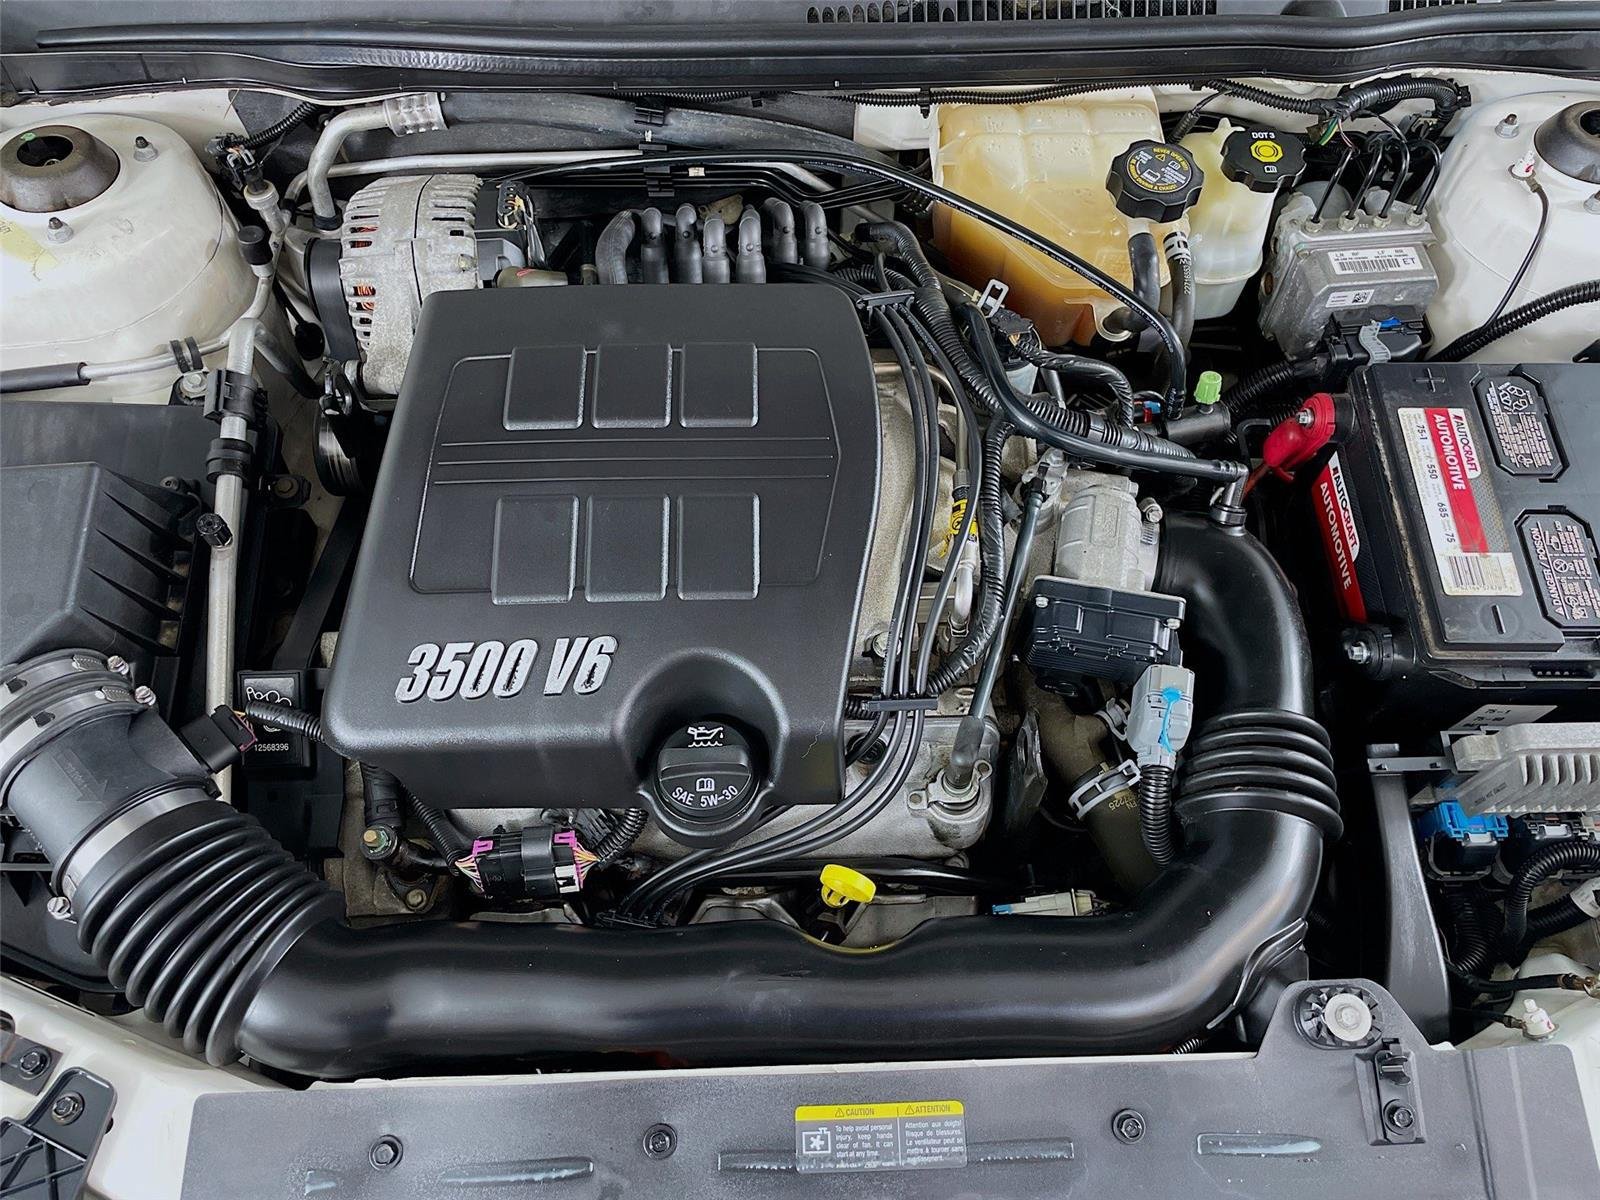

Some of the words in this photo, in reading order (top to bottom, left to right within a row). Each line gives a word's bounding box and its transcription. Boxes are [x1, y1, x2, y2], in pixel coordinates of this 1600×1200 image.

[1402, 257, 1416, 266] ET
[1432, 413, 1466, 491] AUTOMOTIVE
[1454, 419, 1478, 473] AUTOCRAFT
[1416, 424, 1429, 440] 75-1
[1426, 464, 1439, 480] 550
[1444, 532, 1456, 543] 75
[1333, 472, 1359, 548] AUTOCRAFT
[1320, 481, 1352, 590] AUTOMOTIVE
[1530, 527, 1548, 561] POISON
[1542, 568, 1562, 606] DANGER
[394, 640, 539, 704] 3500
[543, 635, 619, 697] V6
[254, 743, 290, 752] 12568396
[672, 786, 696, 806] SAE
[700, 784, 739, 808] 5W-30
[845, 1107, 875, 1117] CAUTION
[914, 1103, 951, 1114] ATTENTION
[842, 1125, 855, 1133] help
[855, 1124, 870, 1132] avoid
[870, 1123, 893, 1132] personal
[905, 1121, 929, 1129] Attention
[951, 1145, 965, 1153] sans
